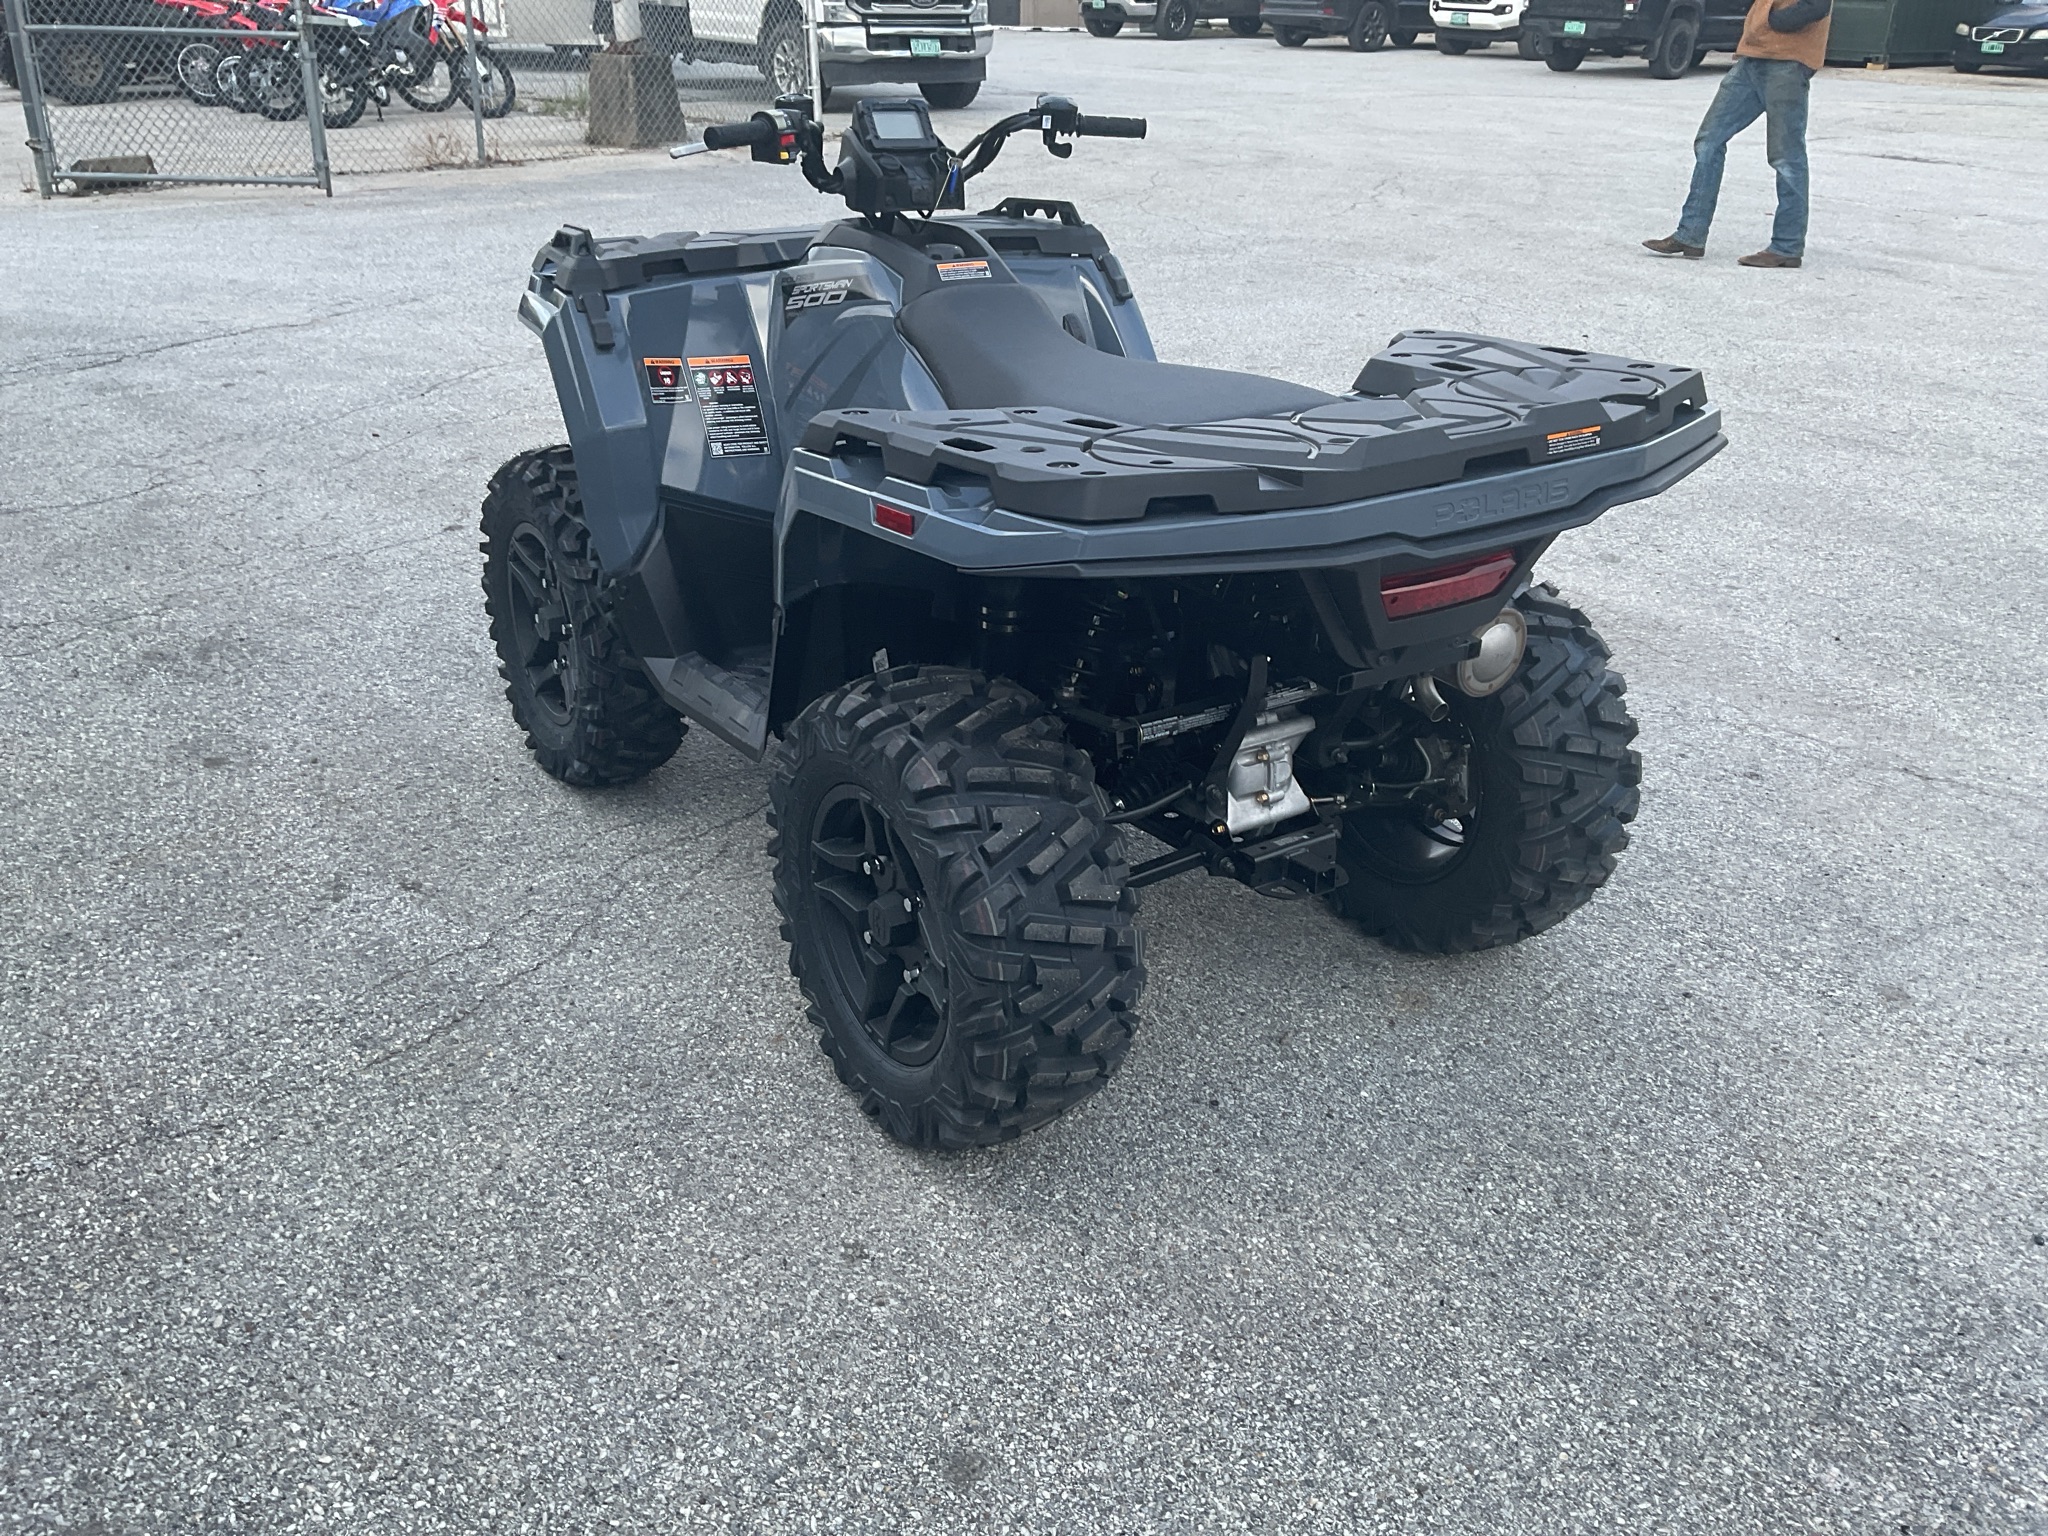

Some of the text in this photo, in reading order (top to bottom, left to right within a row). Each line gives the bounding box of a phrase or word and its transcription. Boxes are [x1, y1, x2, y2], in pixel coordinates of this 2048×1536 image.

[792, 279, 854, 296] SPORTSMAN
[784, 289, 848, 310] 500
[1432, 478, 1570, 530] POLARIS
